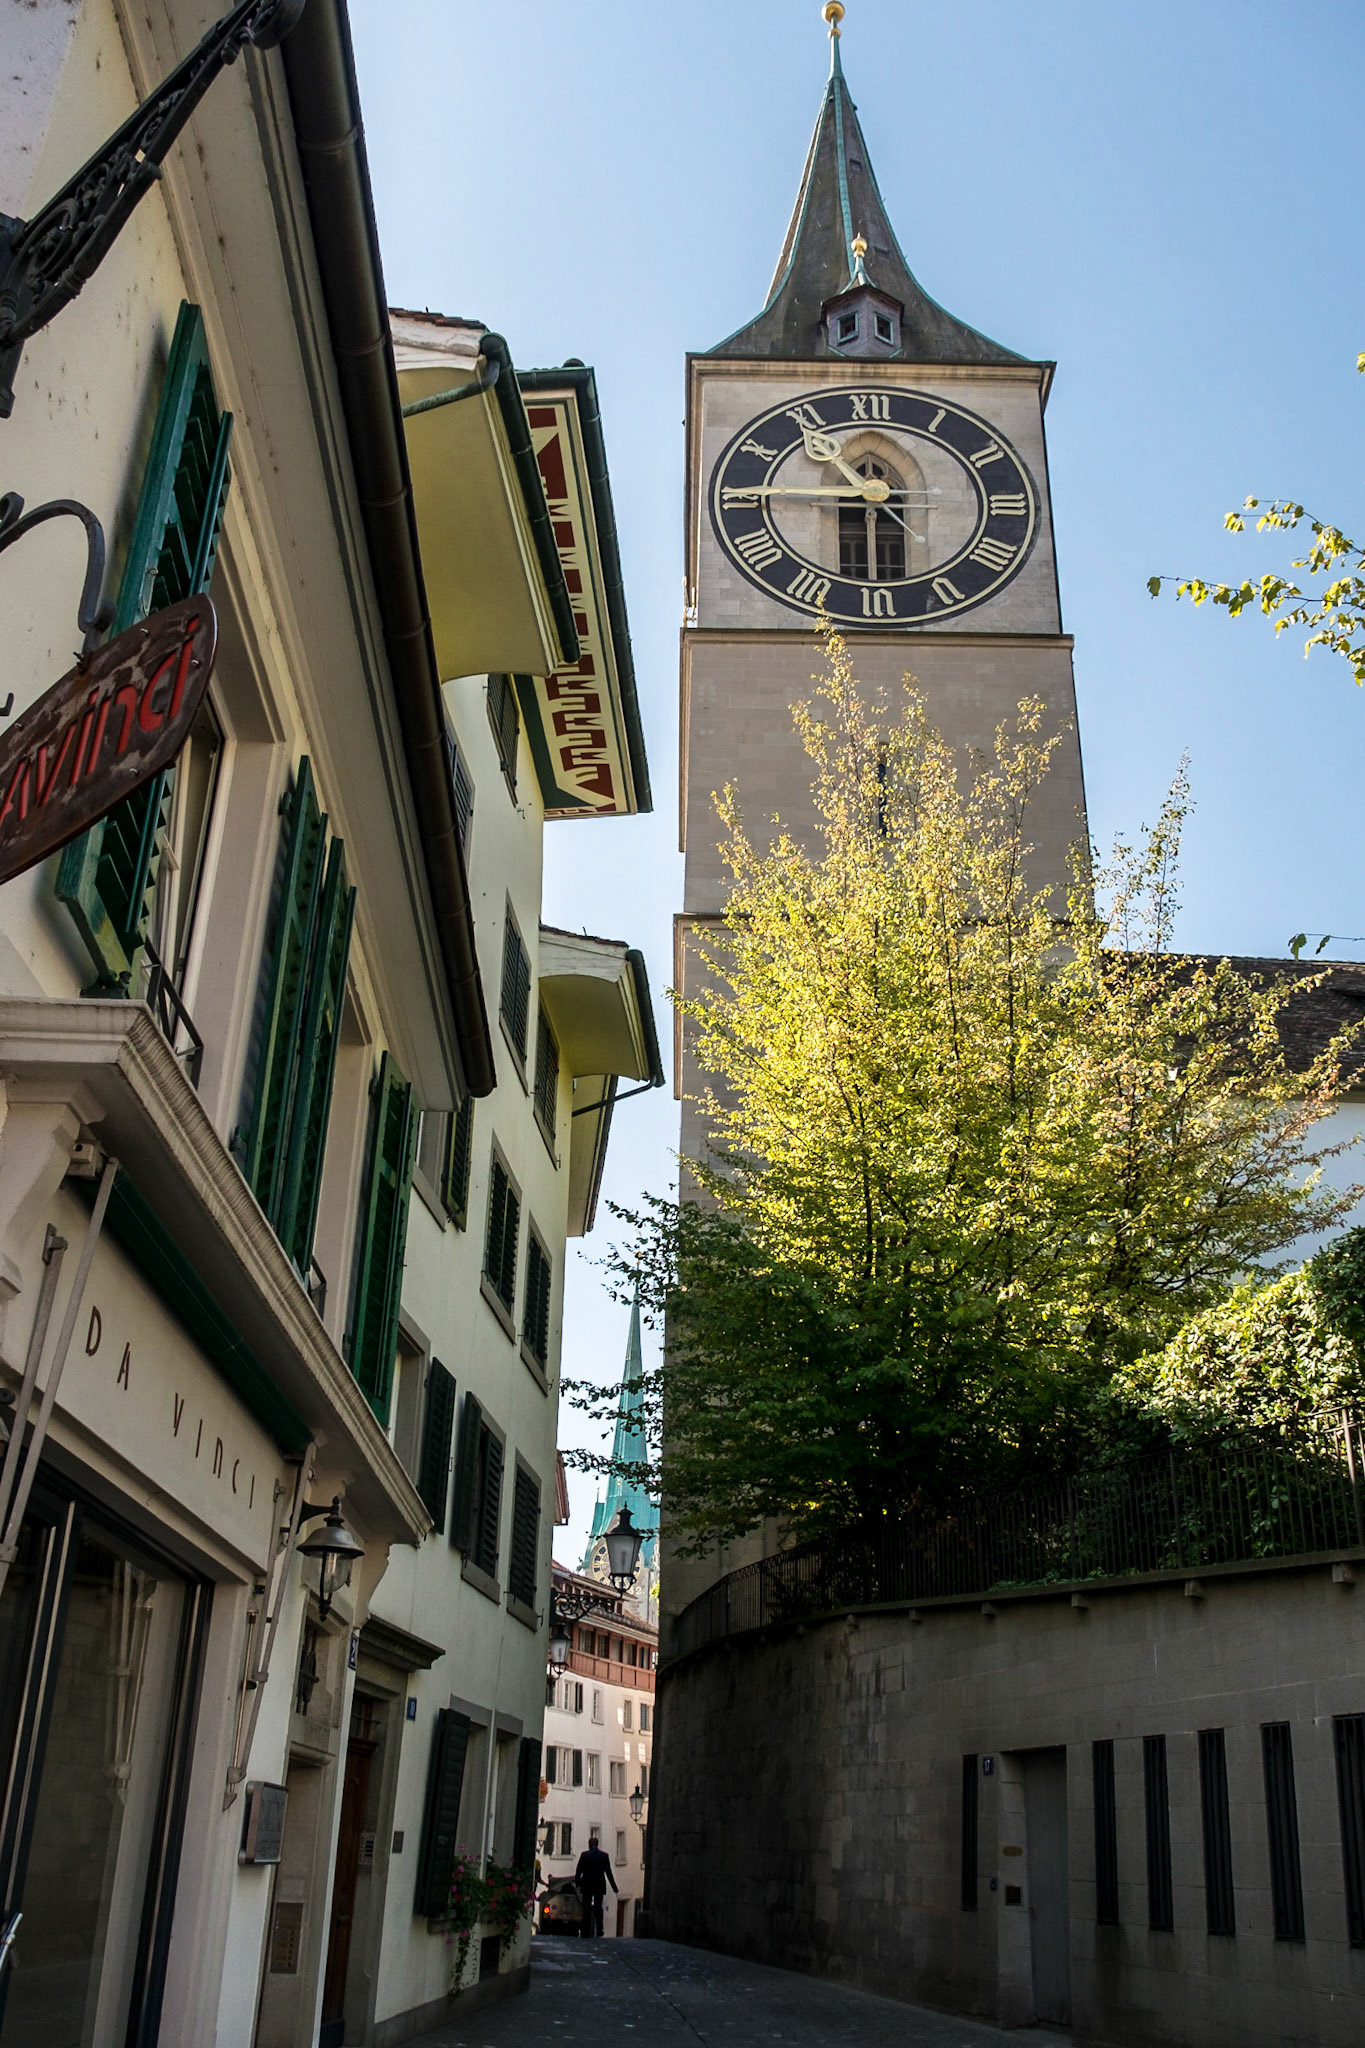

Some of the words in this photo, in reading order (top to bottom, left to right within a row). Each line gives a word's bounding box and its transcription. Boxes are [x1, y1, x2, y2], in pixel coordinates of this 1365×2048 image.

[785, 403, 827, 432] XI
[848, 394, 892, 420] XII
[927, 408, 947, 433] I
[740, 438, 779, 462] X
[969, 443, 1005, 468] II
[989, 492, 1027, 516] III
[968, 536, 1018, 573] IIII
[86, 1305, 131, 1391] DA
